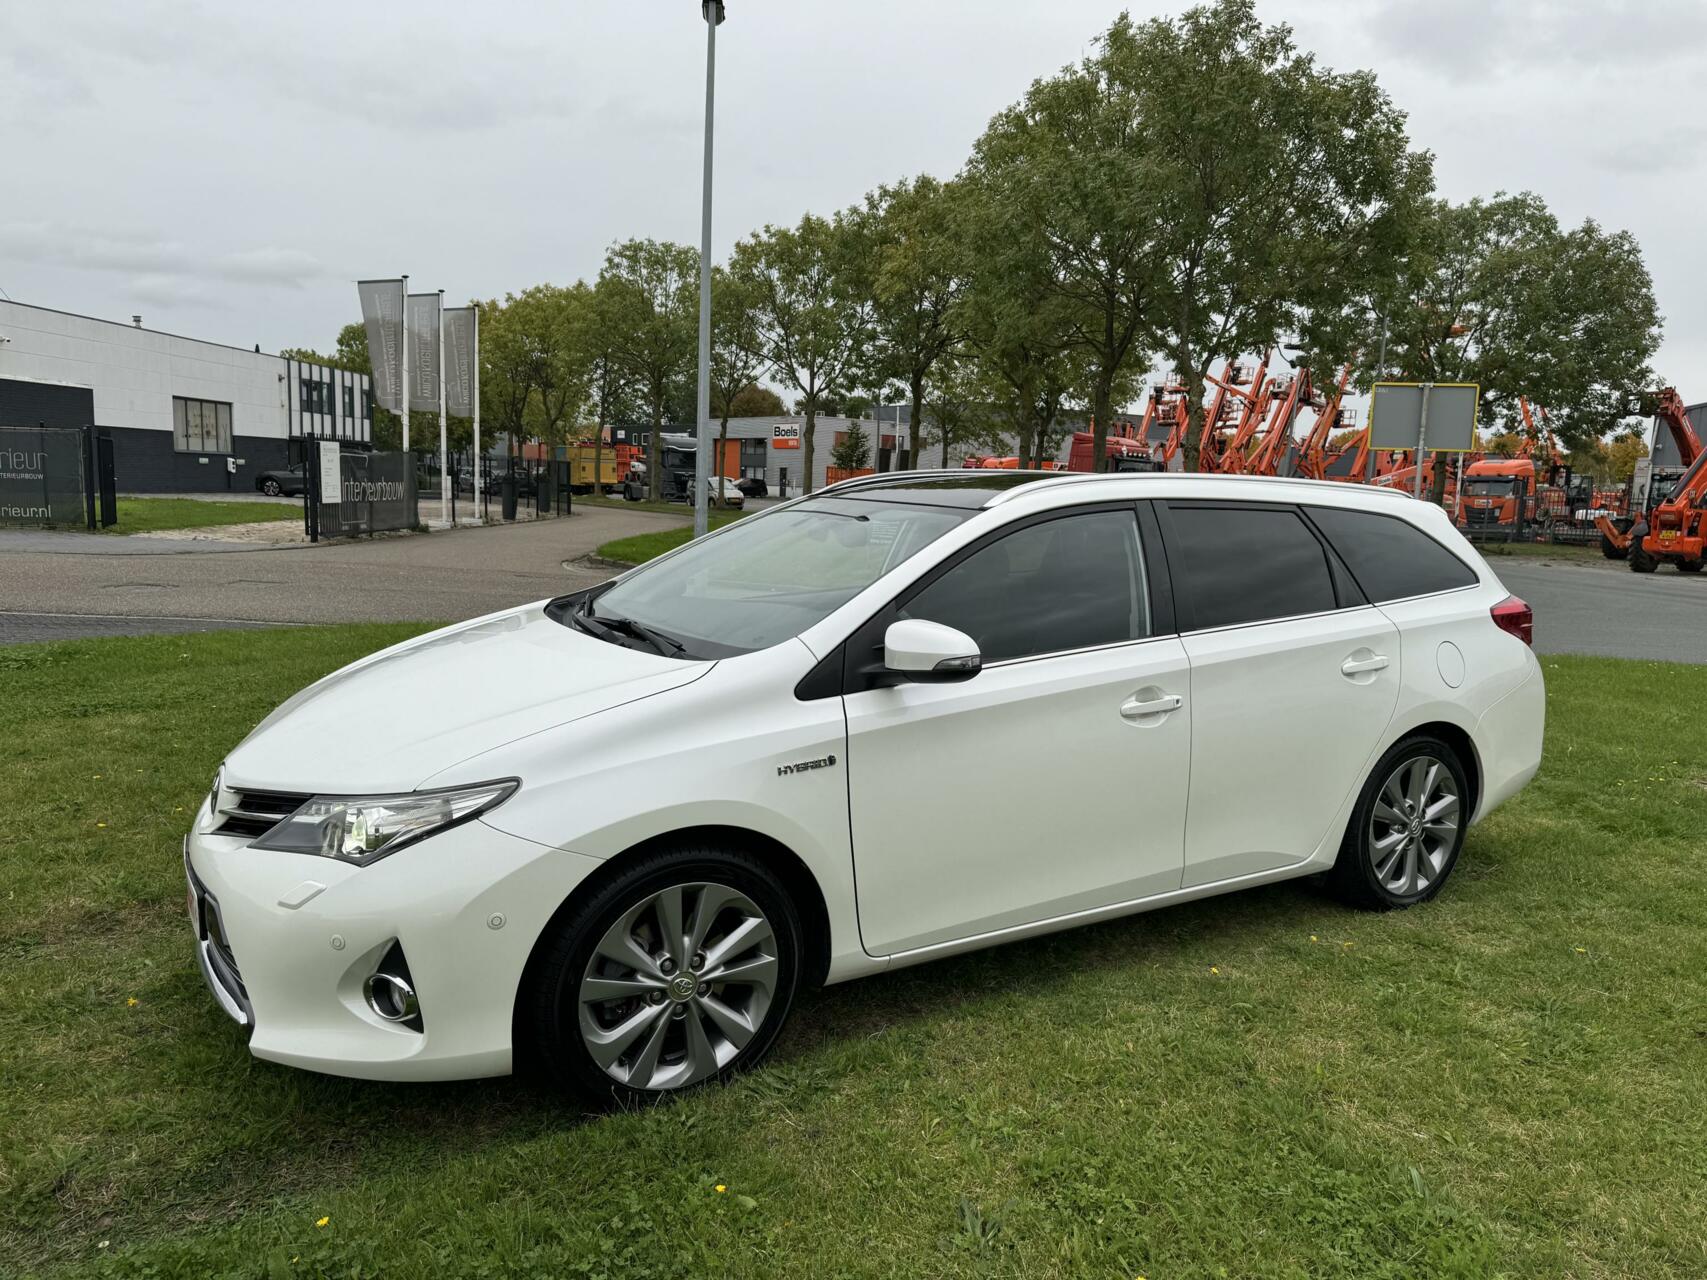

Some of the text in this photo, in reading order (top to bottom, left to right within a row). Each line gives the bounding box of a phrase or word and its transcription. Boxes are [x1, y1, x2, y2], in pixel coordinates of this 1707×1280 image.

[773, 426, 798, 437] Boels
[341, 475, 404, 502] Interieurbouw
[1, 503, 52, 518] rieur.nl
